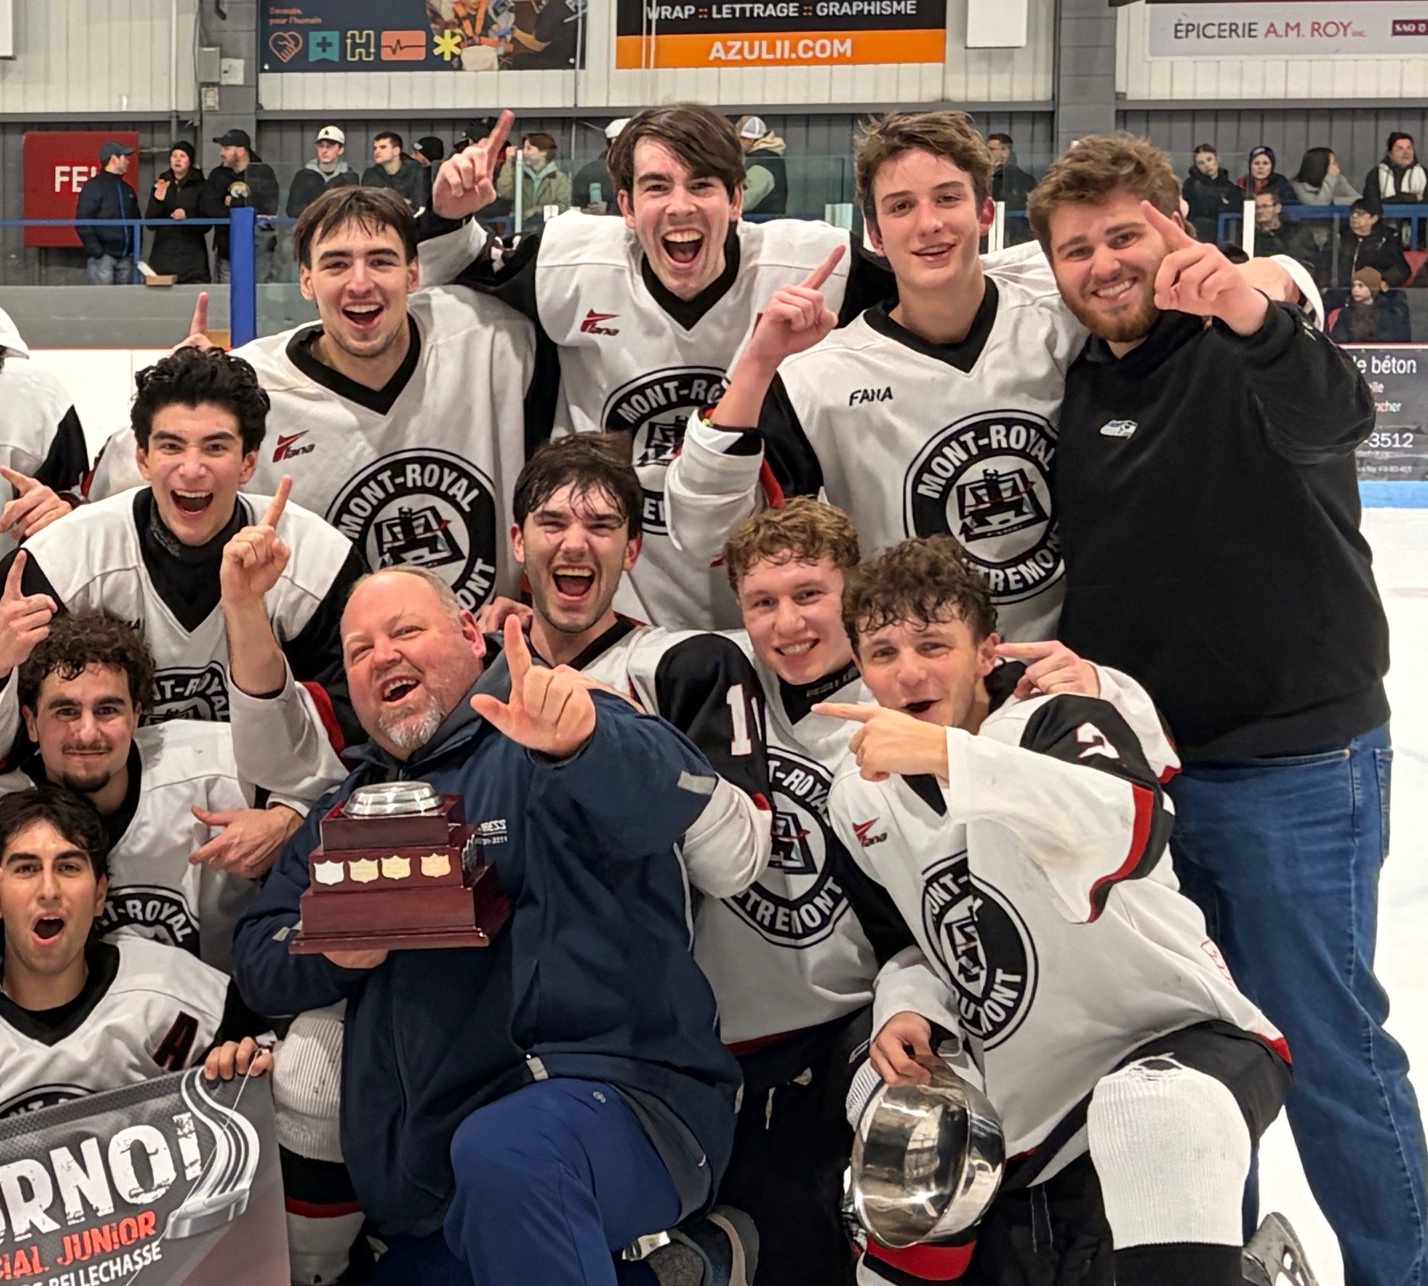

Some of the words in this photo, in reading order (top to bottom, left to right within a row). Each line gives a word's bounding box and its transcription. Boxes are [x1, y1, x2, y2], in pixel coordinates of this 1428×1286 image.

[647, 5, 695, 20] WRAP
[712, 3, 799, 18] LETTRAGE
[816, 0, 916, 15] GRAPHISME
[1174, 18, 1258, 39] ÉPICERIE
[1264, 22, 1305, 38] A.M.
[1311, 21, 1352, 38] ROY
[709, 38, 852, 61] AZULII.COM
[54, 166, 99, 193] FE
[1371, 354, 1418, 375] béton
[338, 463, 480, 540] MONT-ROYAL
[152, 1010, 199, 1072] A
[56, 1209, 157, 1265] JUNIOR
